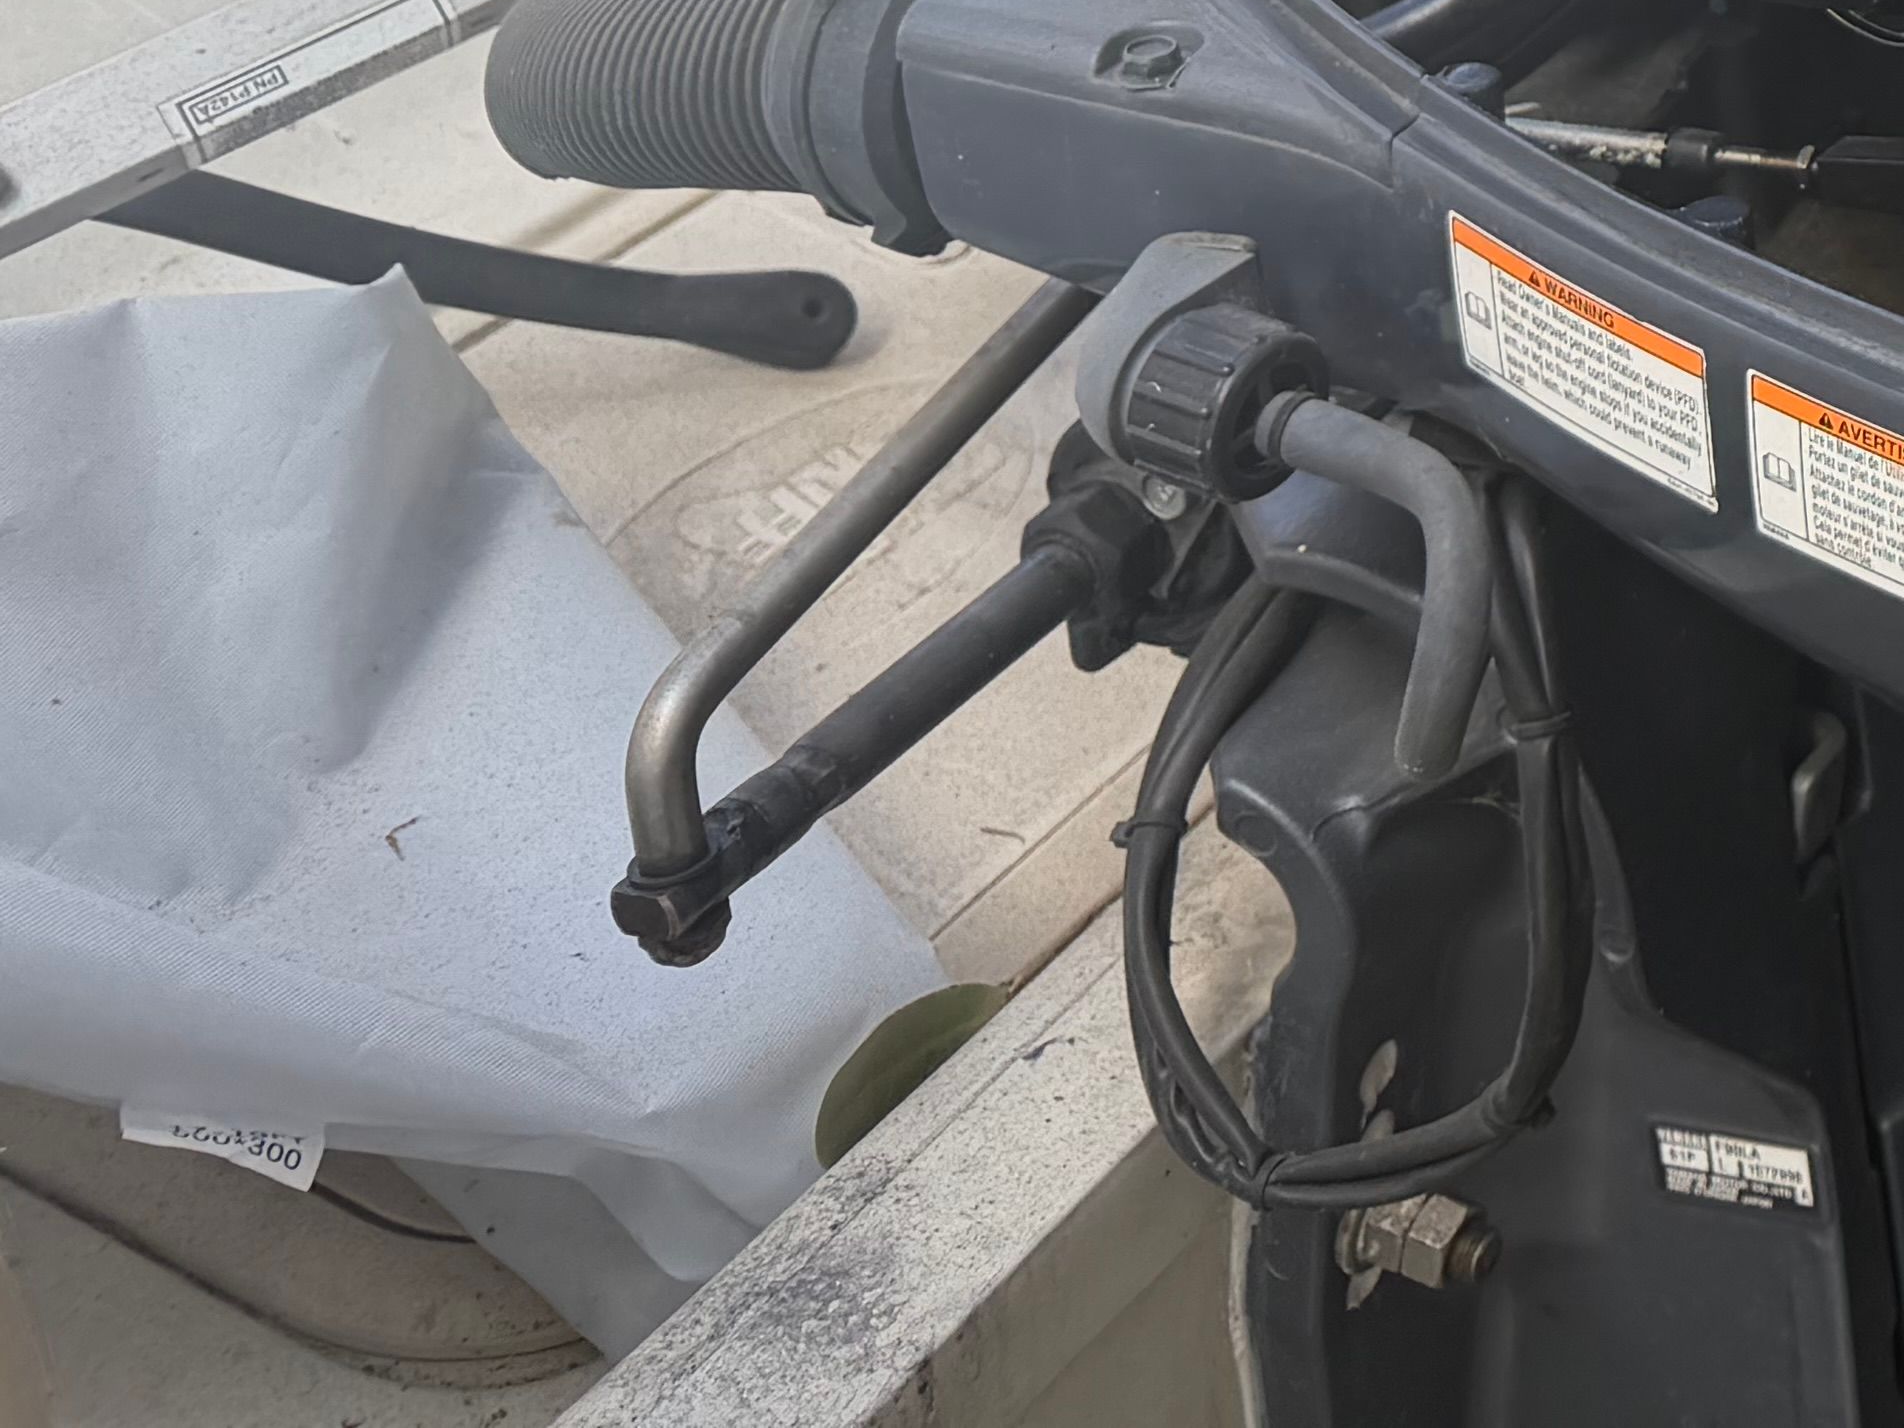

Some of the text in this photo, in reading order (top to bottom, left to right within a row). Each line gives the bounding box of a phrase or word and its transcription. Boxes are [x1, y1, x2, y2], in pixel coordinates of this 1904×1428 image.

[252, 70, 280, 93] PN
[1544, 277, 1614, 329] WARNING
[1808, 427, 1825, 447] Lire
[1826, 435, 1834, 452] le
[1836, 439, 1866, 465] Manuel
[1868, 455, 1879, 471] de
[1808, 444, 1835, 470] Portez
[1837, 462, 1848, 474] un
[1850, 466, 1869, 484] gilet
[1870, 472, 1880, 489] de
[1809, 463, 1845, 492] Attachez
[1847, 480, 1855, 496] le
[1857, 488, 1886, 510] cordon
[1811, 484, 1829, 502] gilet
[1831, 492, 1841, 507] de
[1843, 498, 1888, 530] sauvetage,
[1889, 518, 1894, 531] à
[1812, 502, 1841, 524] moteur
[1876, 531, 1882, 542] si
[1813, 514, 1832, 535] Cela
[1833, 527, 1862, 551] permet
[1815, 533, 1834, 550] sans
